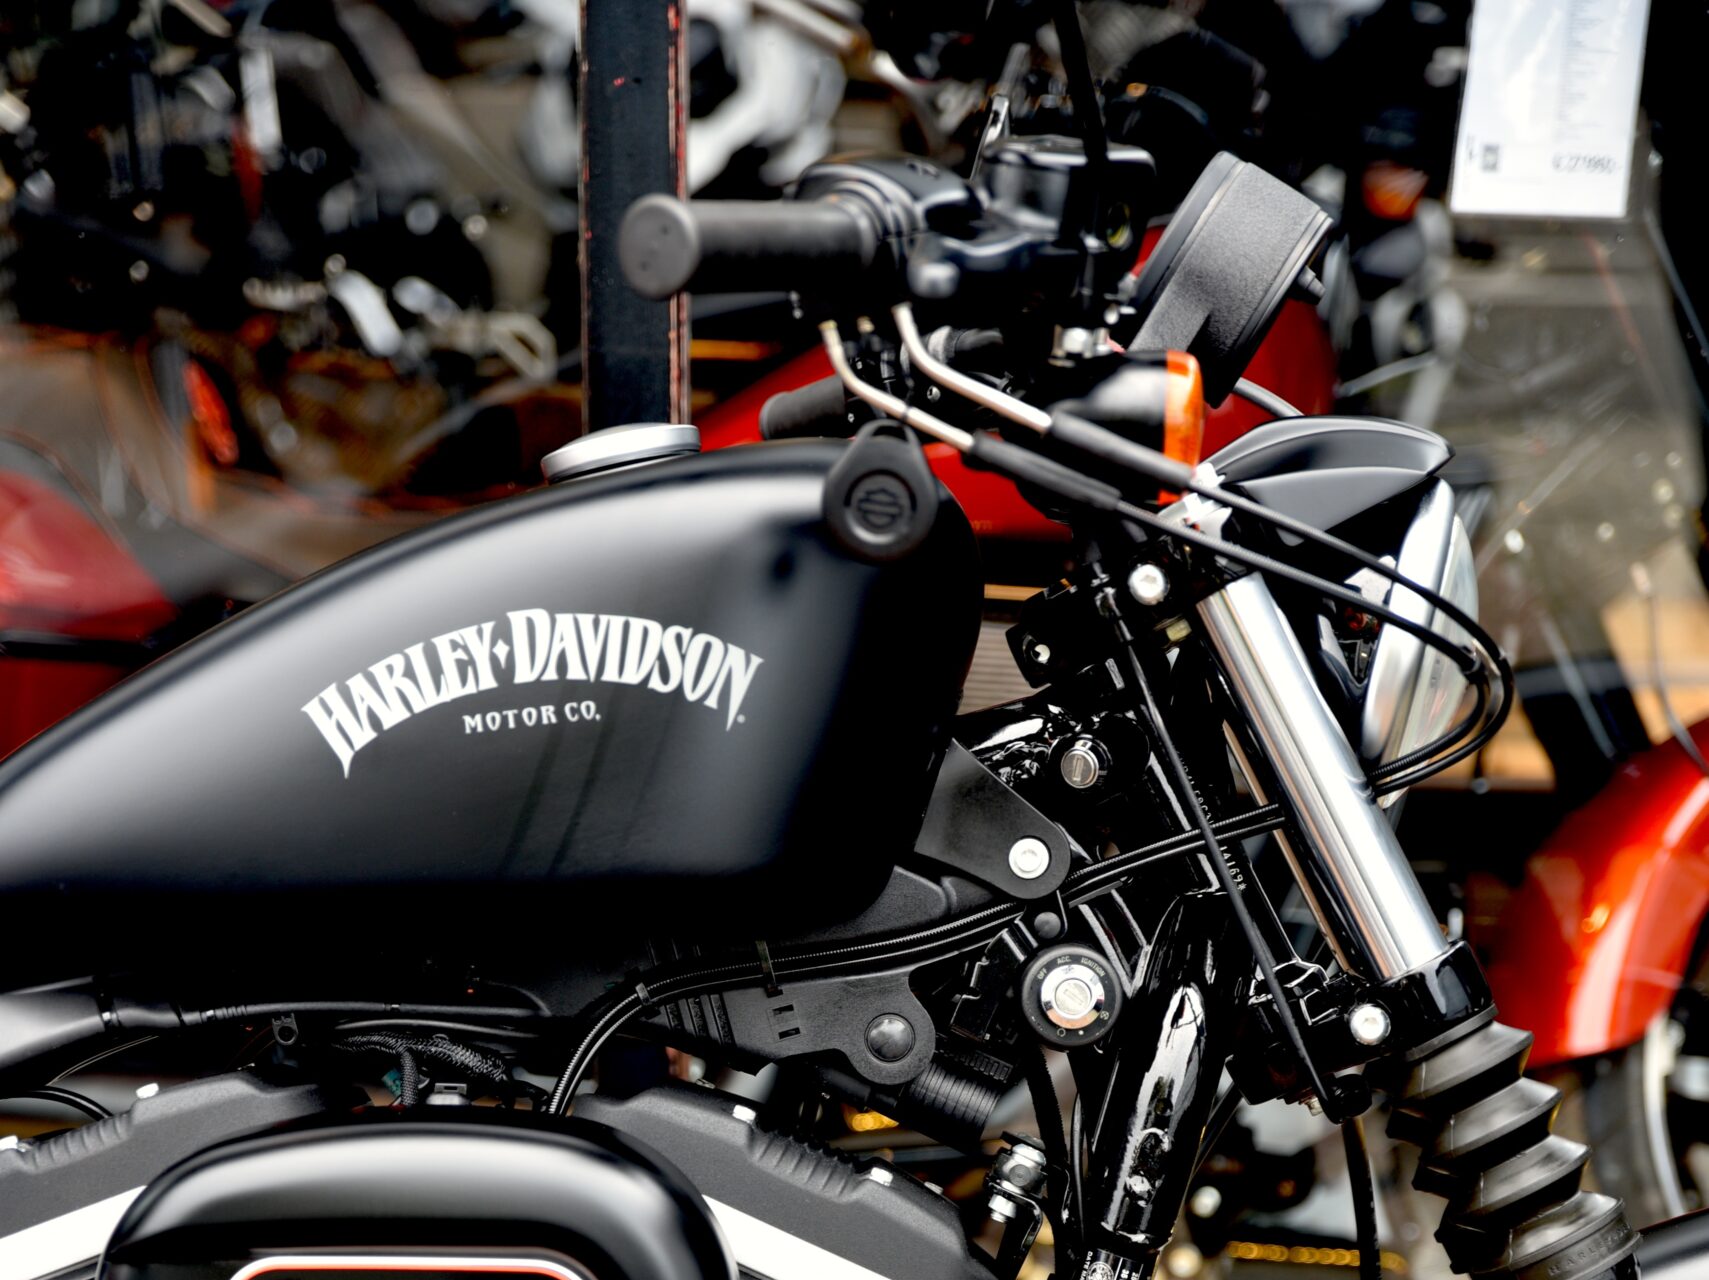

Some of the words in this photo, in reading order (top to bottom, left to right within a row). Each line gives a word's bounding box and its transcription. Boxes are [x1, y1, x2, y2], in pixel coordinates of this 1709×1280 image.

[464, 705, 557, 734] MOTOR
[564, 700, 601, 723] CO.
[1036, 967, 1048, 980] OFF
[1080, 957, 1106, 978] IGNITION
[1082, 1250, 1092, 1269] DATE
